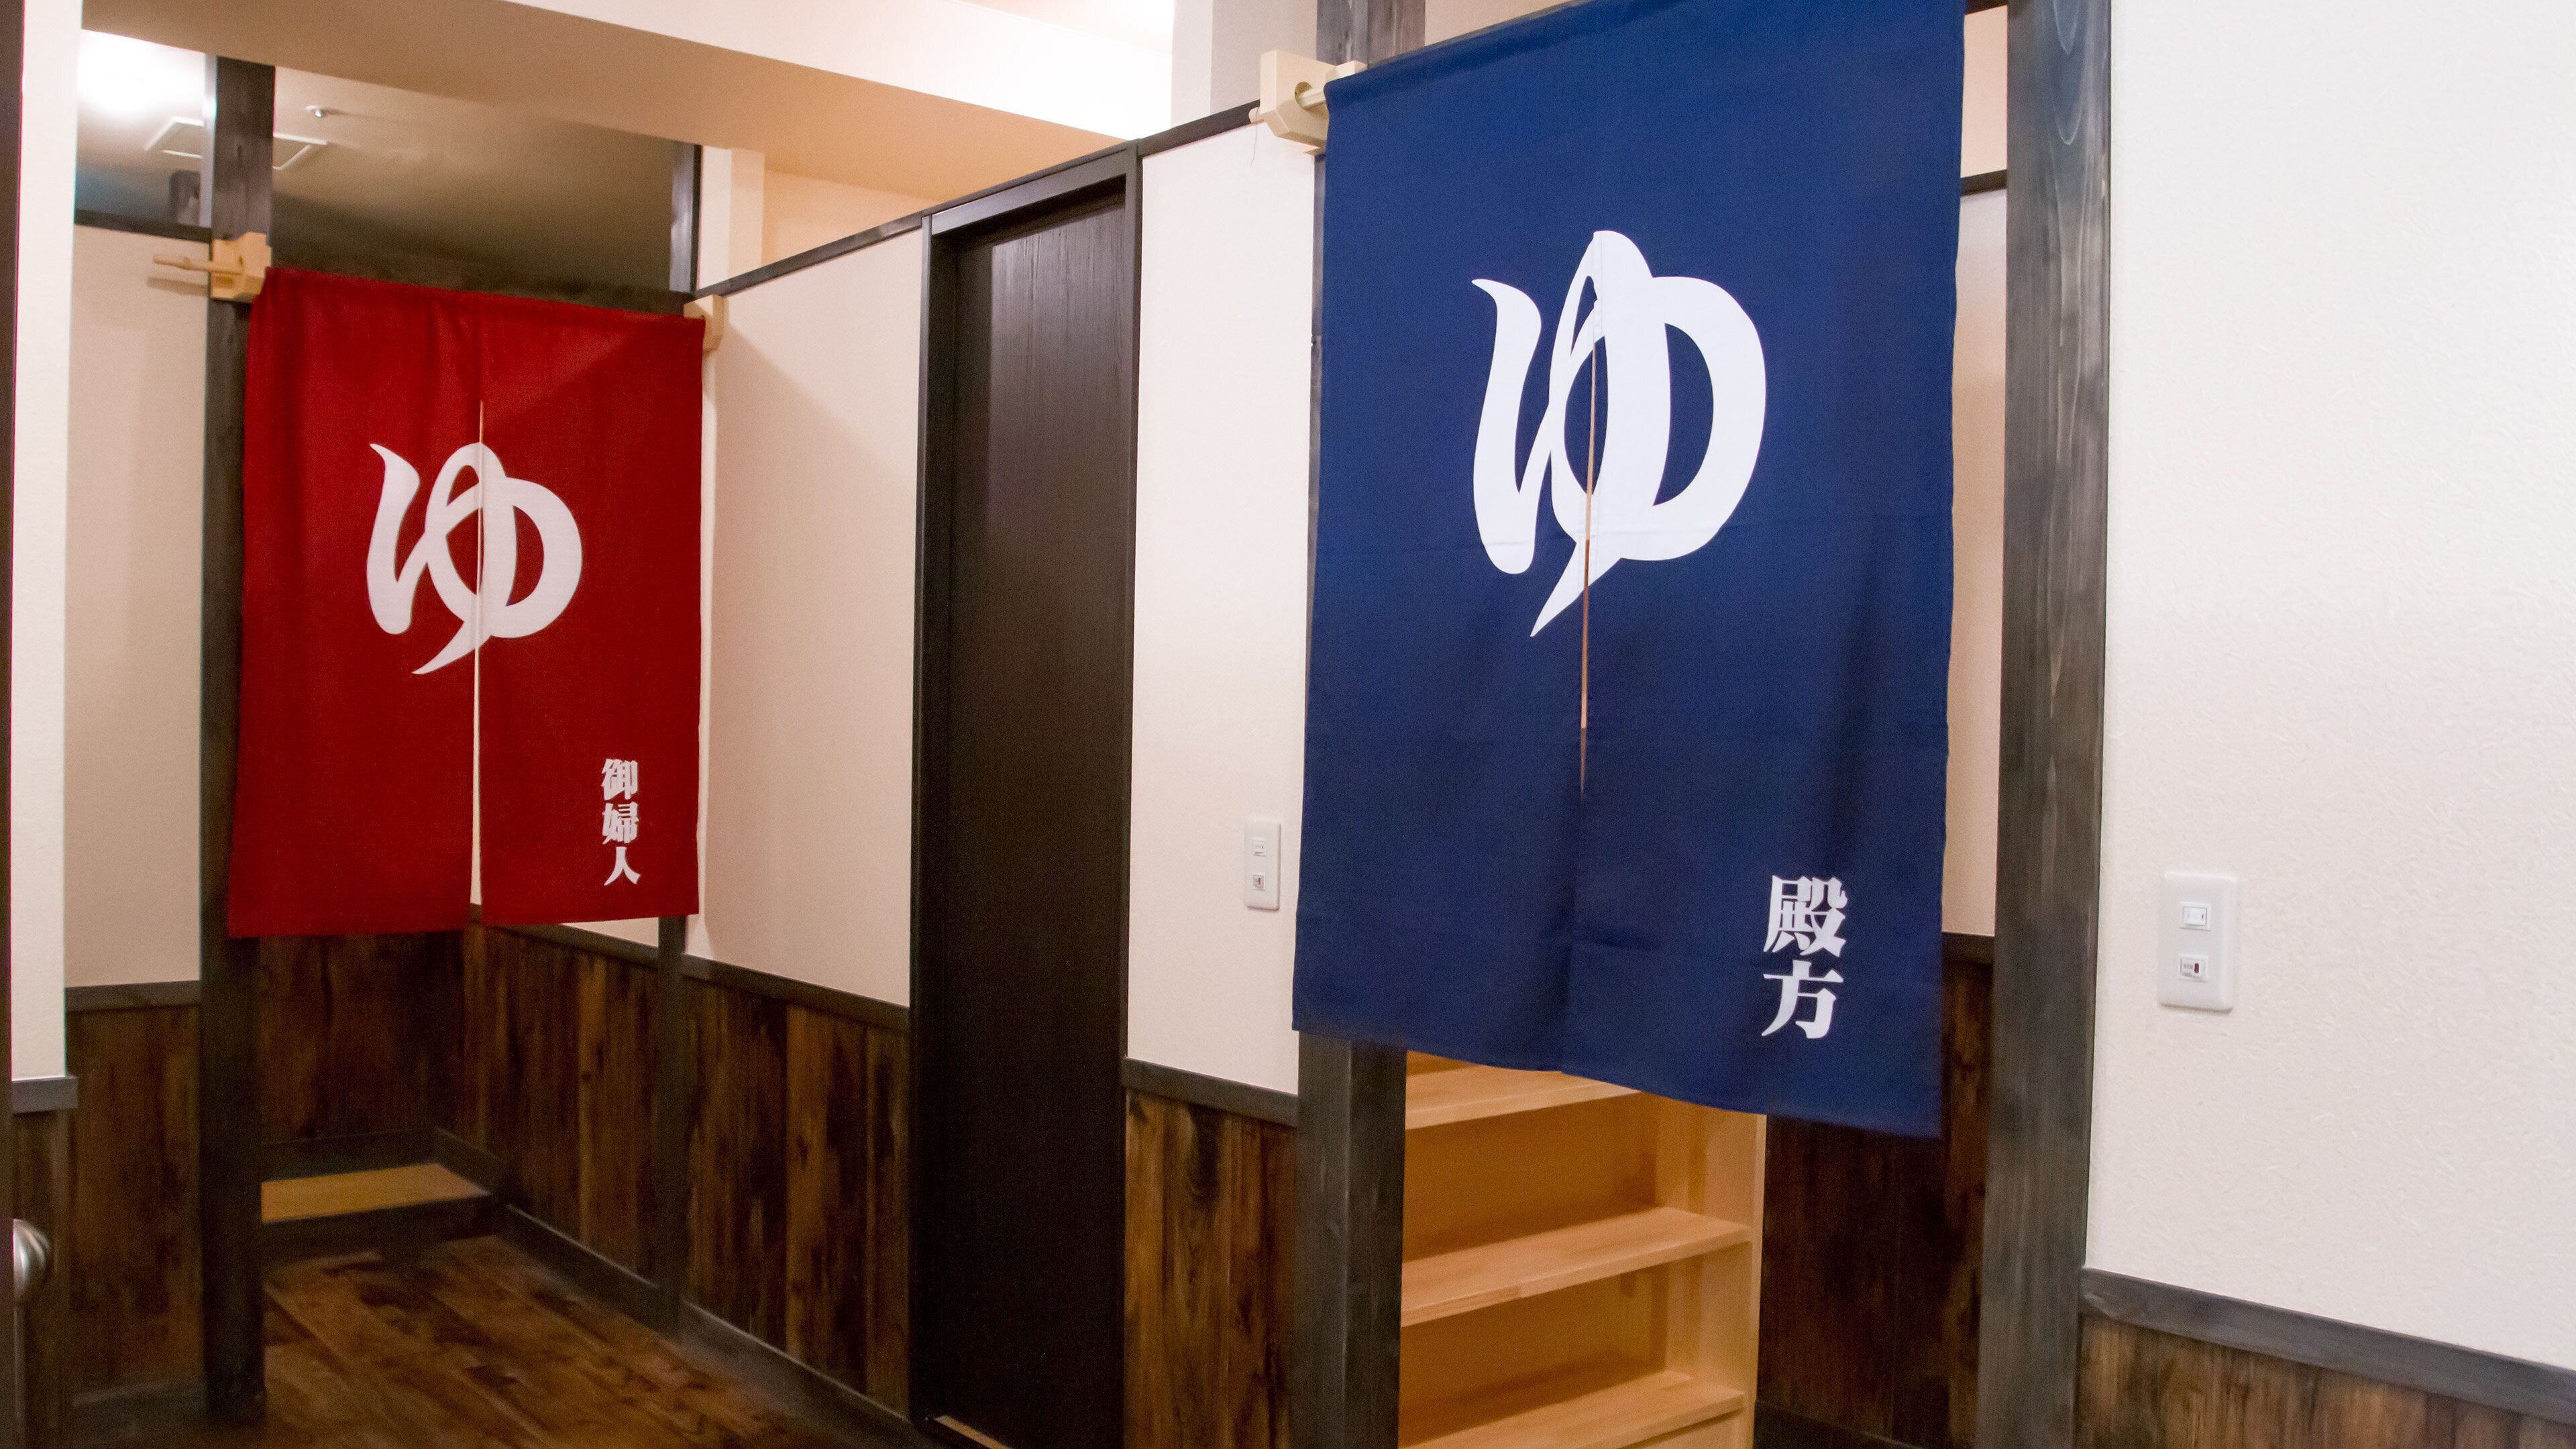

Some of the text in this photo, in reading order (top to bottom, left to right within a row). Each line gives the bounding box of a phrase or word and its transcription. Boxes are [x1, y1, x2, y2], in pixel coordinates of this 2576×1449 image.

[1472, 230, 1767, 637] ゆ
[366, 442, 583, 675] ゆ
[601, 758, 641, 886] 御婦人
[1761, 875, 1849, 1039] 殿方
